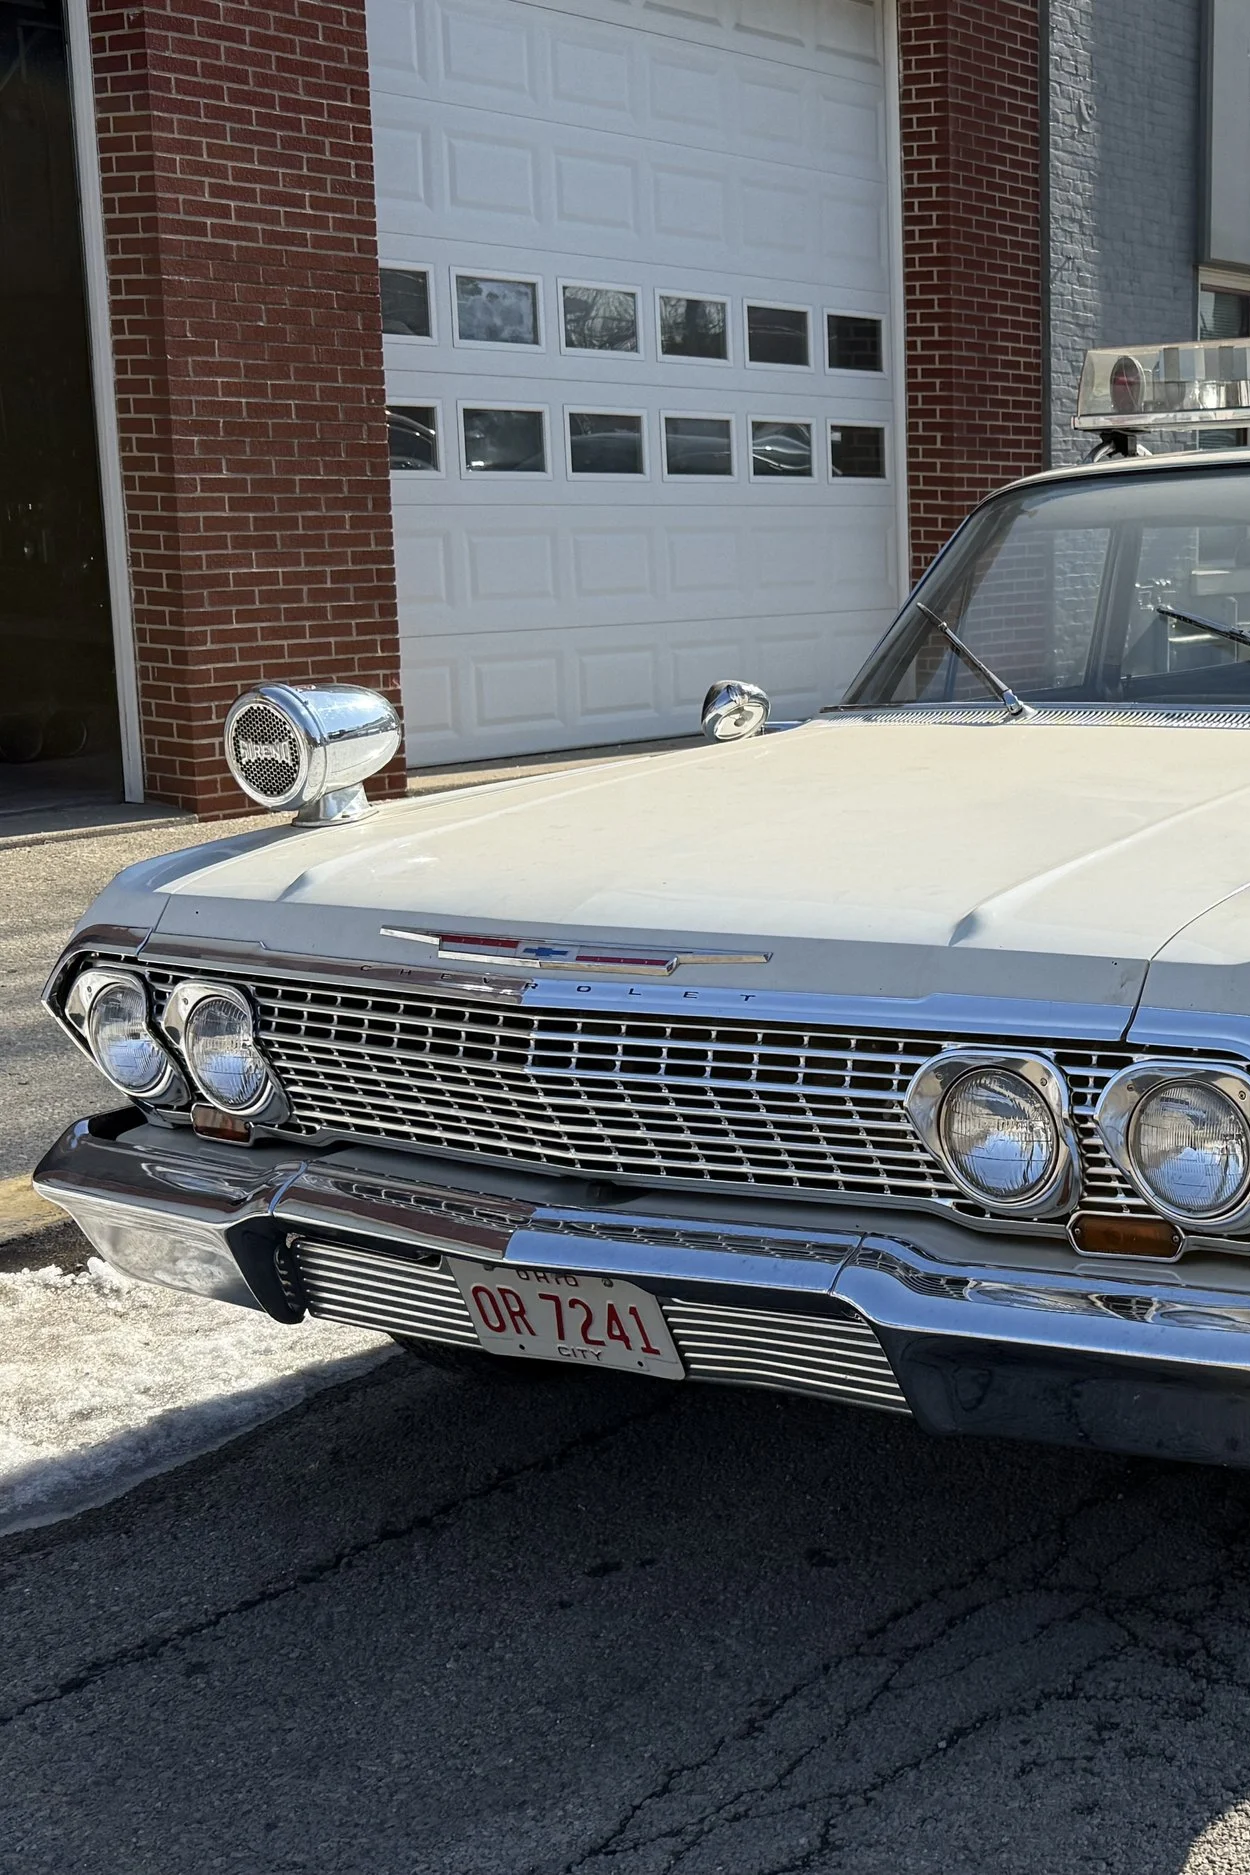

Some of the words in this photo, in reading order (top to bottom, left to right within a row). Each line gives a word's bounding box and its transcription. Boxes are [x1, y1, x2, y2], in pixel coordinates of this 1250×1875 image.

[359, 965, 757, 1003] CHEVROLET
[516, 1269, 579, 1288] OHIO
[471, 1285, 536, 1337] OR
[538, 1292, 661, 1356] 7241
[557, 1345, 602, 1362] CITY
